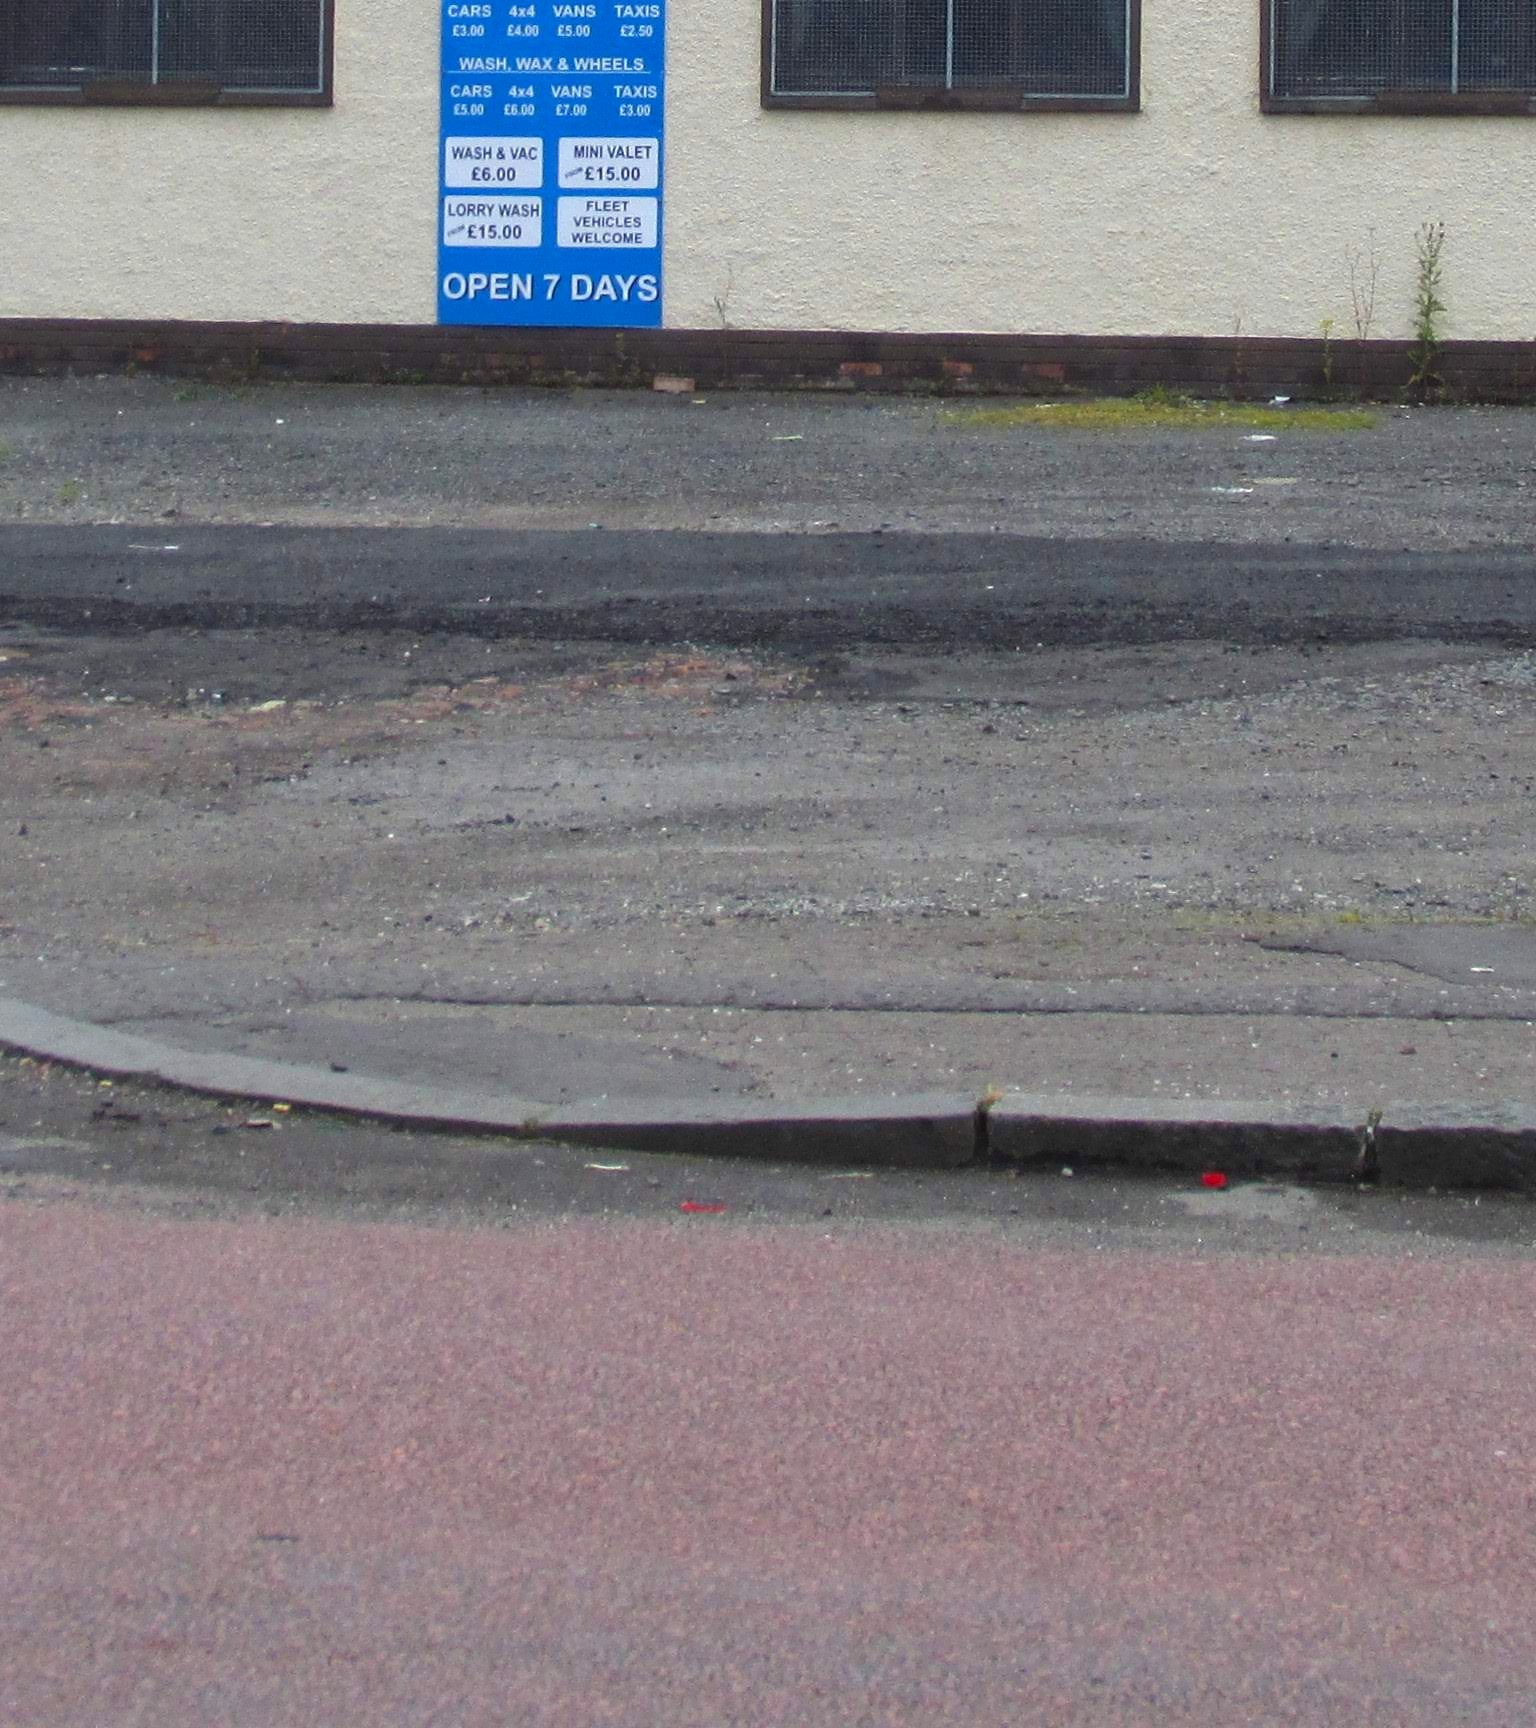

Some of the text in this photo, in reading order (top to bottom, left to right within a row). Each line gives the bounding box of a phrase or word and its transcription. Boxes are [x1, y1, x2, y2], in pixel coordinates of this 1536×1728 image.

[448, 5, 659, 17] CARS 4x4 VANS TAXIS
[453, 25, 652, 37] £3.00 £4.00 £5.00 £2.50
[516, 58, 552, 70] WAX
[558, 58, 568, 70] &
[574, 58, 643, 71] WHEELS
[451, 85, 657, 98] CARS 4x4 VANS TAXIS
[454, 104, 651, 116] £5.00 £6.00 £7.00 £3.00
[452, 146, 537, 160] WASH & VAC
[574, 145, 652, 159] MINI VALET
[472, 167, 516, 181] £6.00
[585, 167, 640, 181] £15.00
[448, 204, 540, 217] LORRY WASH
[586, 201, 630, 211] FLEET
[574, 217, 642, 227] VEHICLES
[467, 225, 521, 239] £15.00
[572, 233, 642, 243] WELCOME
[443, 273, 658, 301] OPEN 7 DAYS
